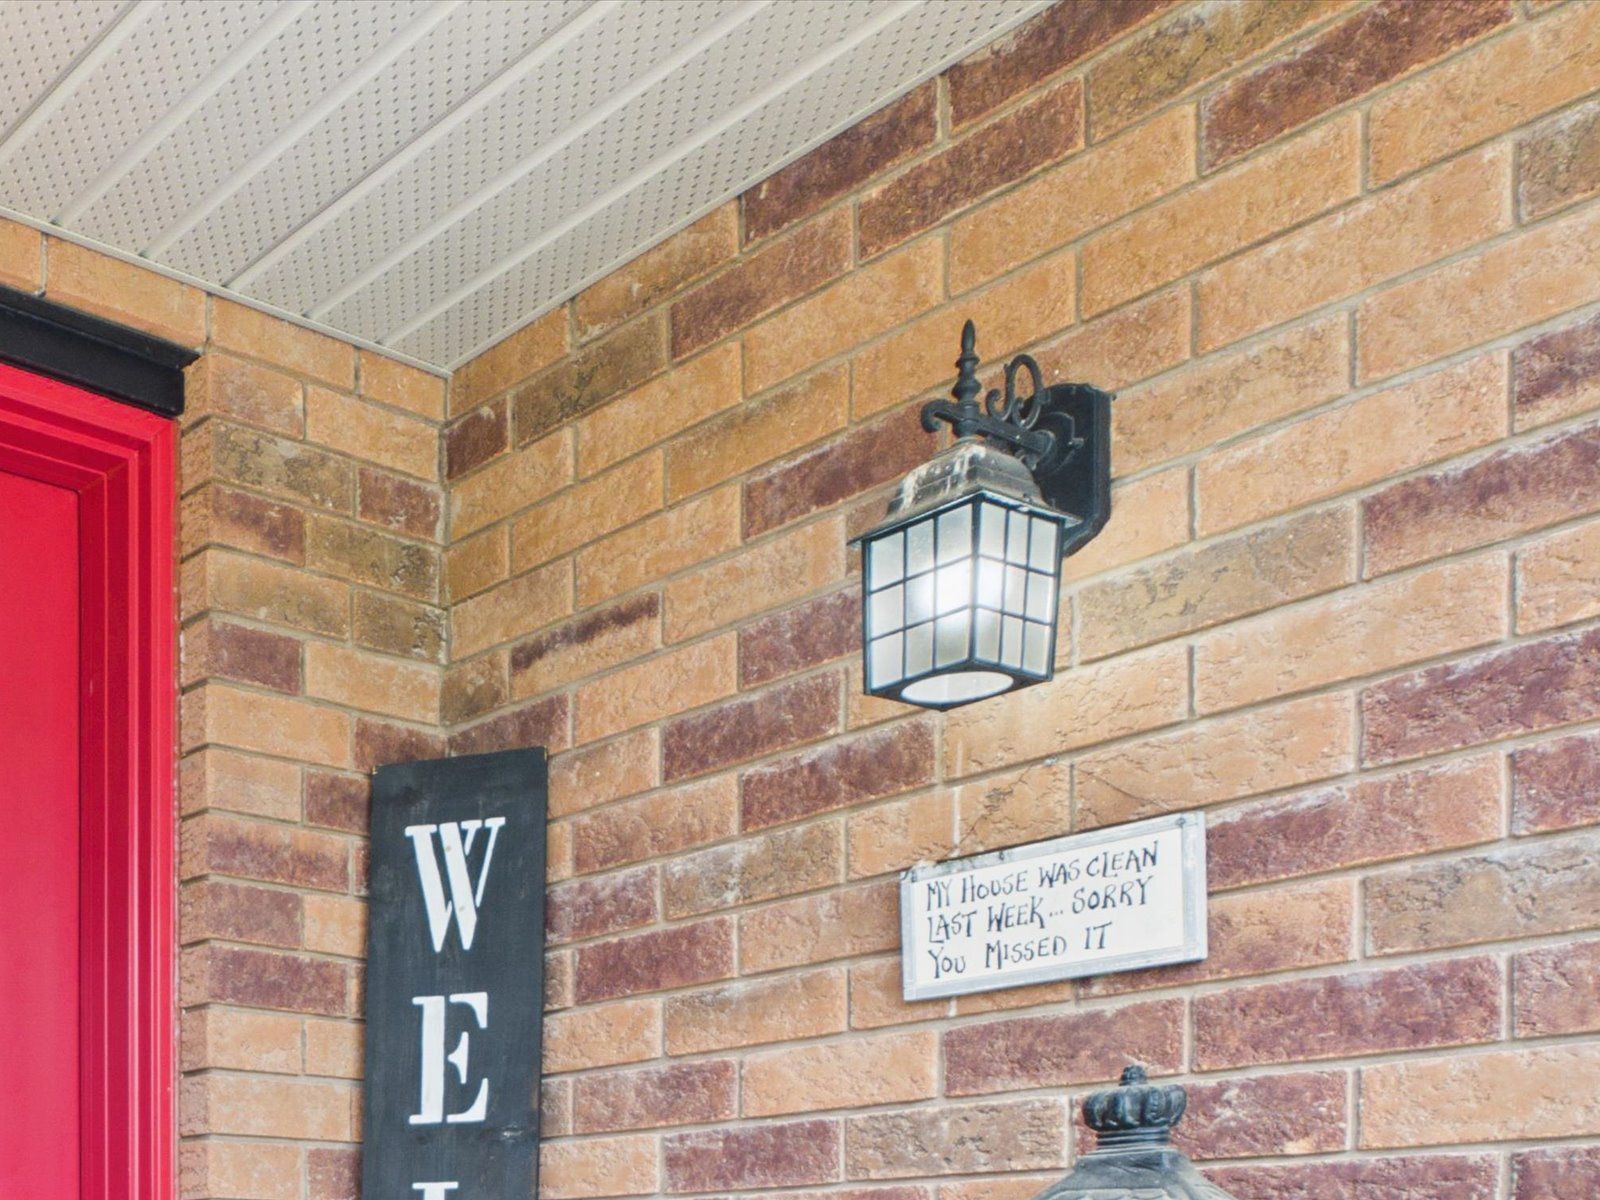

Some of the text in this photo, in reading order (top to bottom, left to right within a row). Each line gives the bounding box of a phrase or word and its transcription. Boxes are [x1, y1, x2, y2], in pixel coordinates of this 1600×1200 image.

[926, 839, 1159, 912] MY HOUSE WAS CLEAN
[926, 909, 978, 944] LAST
[1071, 874, 1155, 915] SORRY
[984, 934, 1068, 971] MISSED
[1083, 920, 1114, 951] IT
